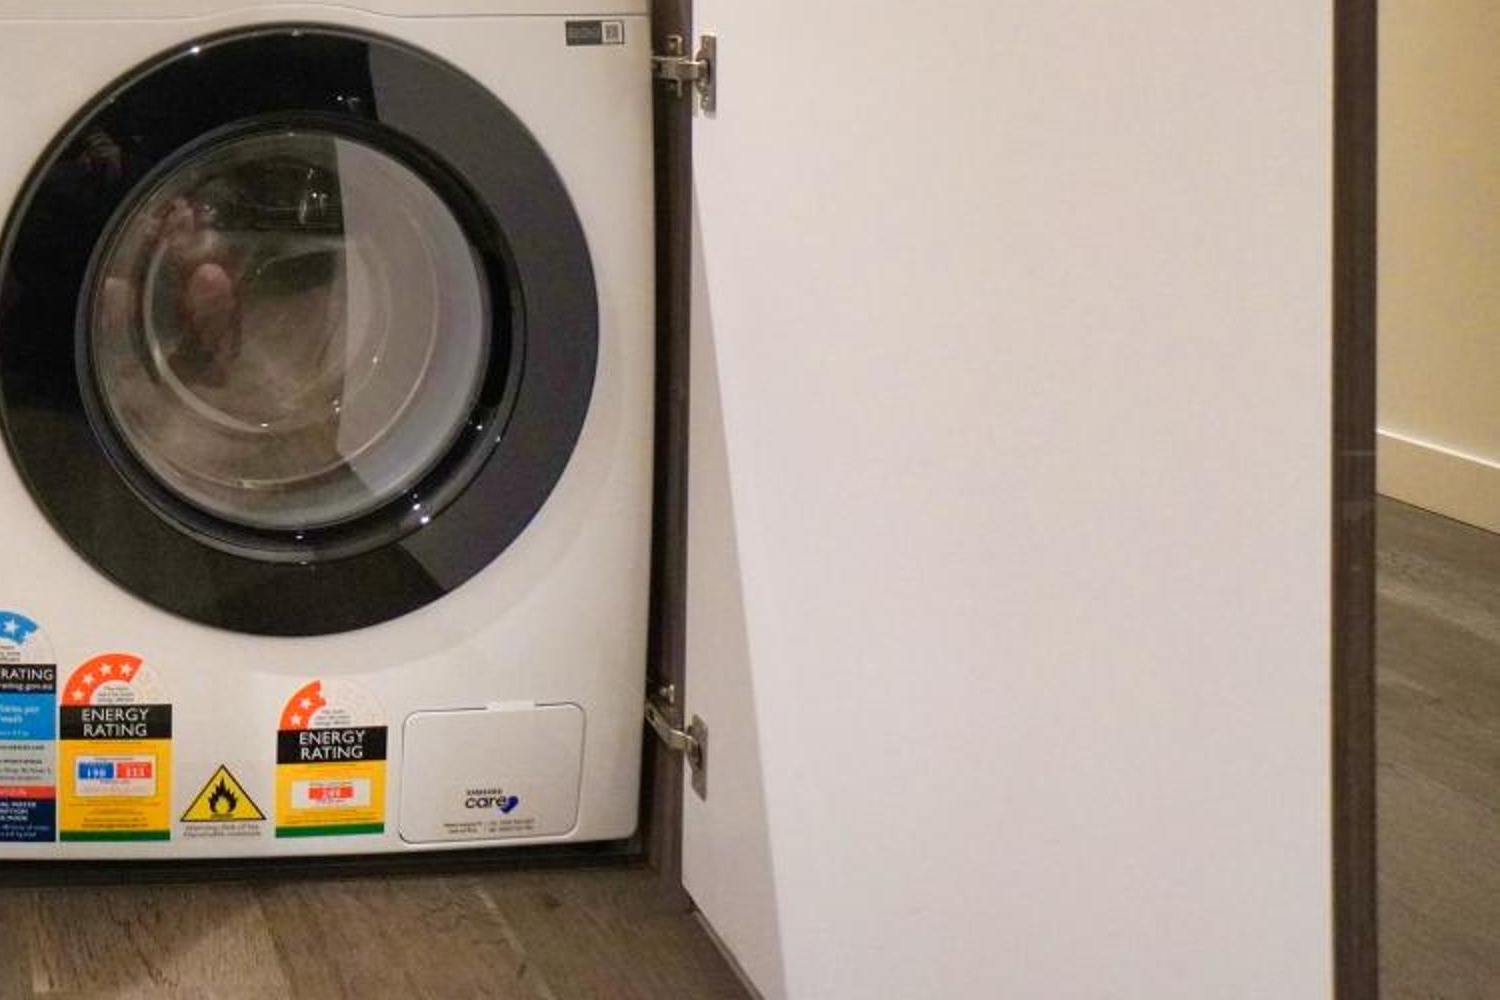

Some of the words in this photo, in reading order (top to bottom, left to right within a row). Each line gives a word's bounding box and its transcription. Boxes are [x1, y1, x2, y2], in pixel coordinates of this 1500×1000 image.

[0, 668, 53, 681] RATING
[81, 707, 149, 722] ENERGY
[82, 723, 148, 737] RATING
[299, 729, 366, 745] ENERGY
[300, 745, 363, 760] RATING
[465, 795, 507, 809] care
